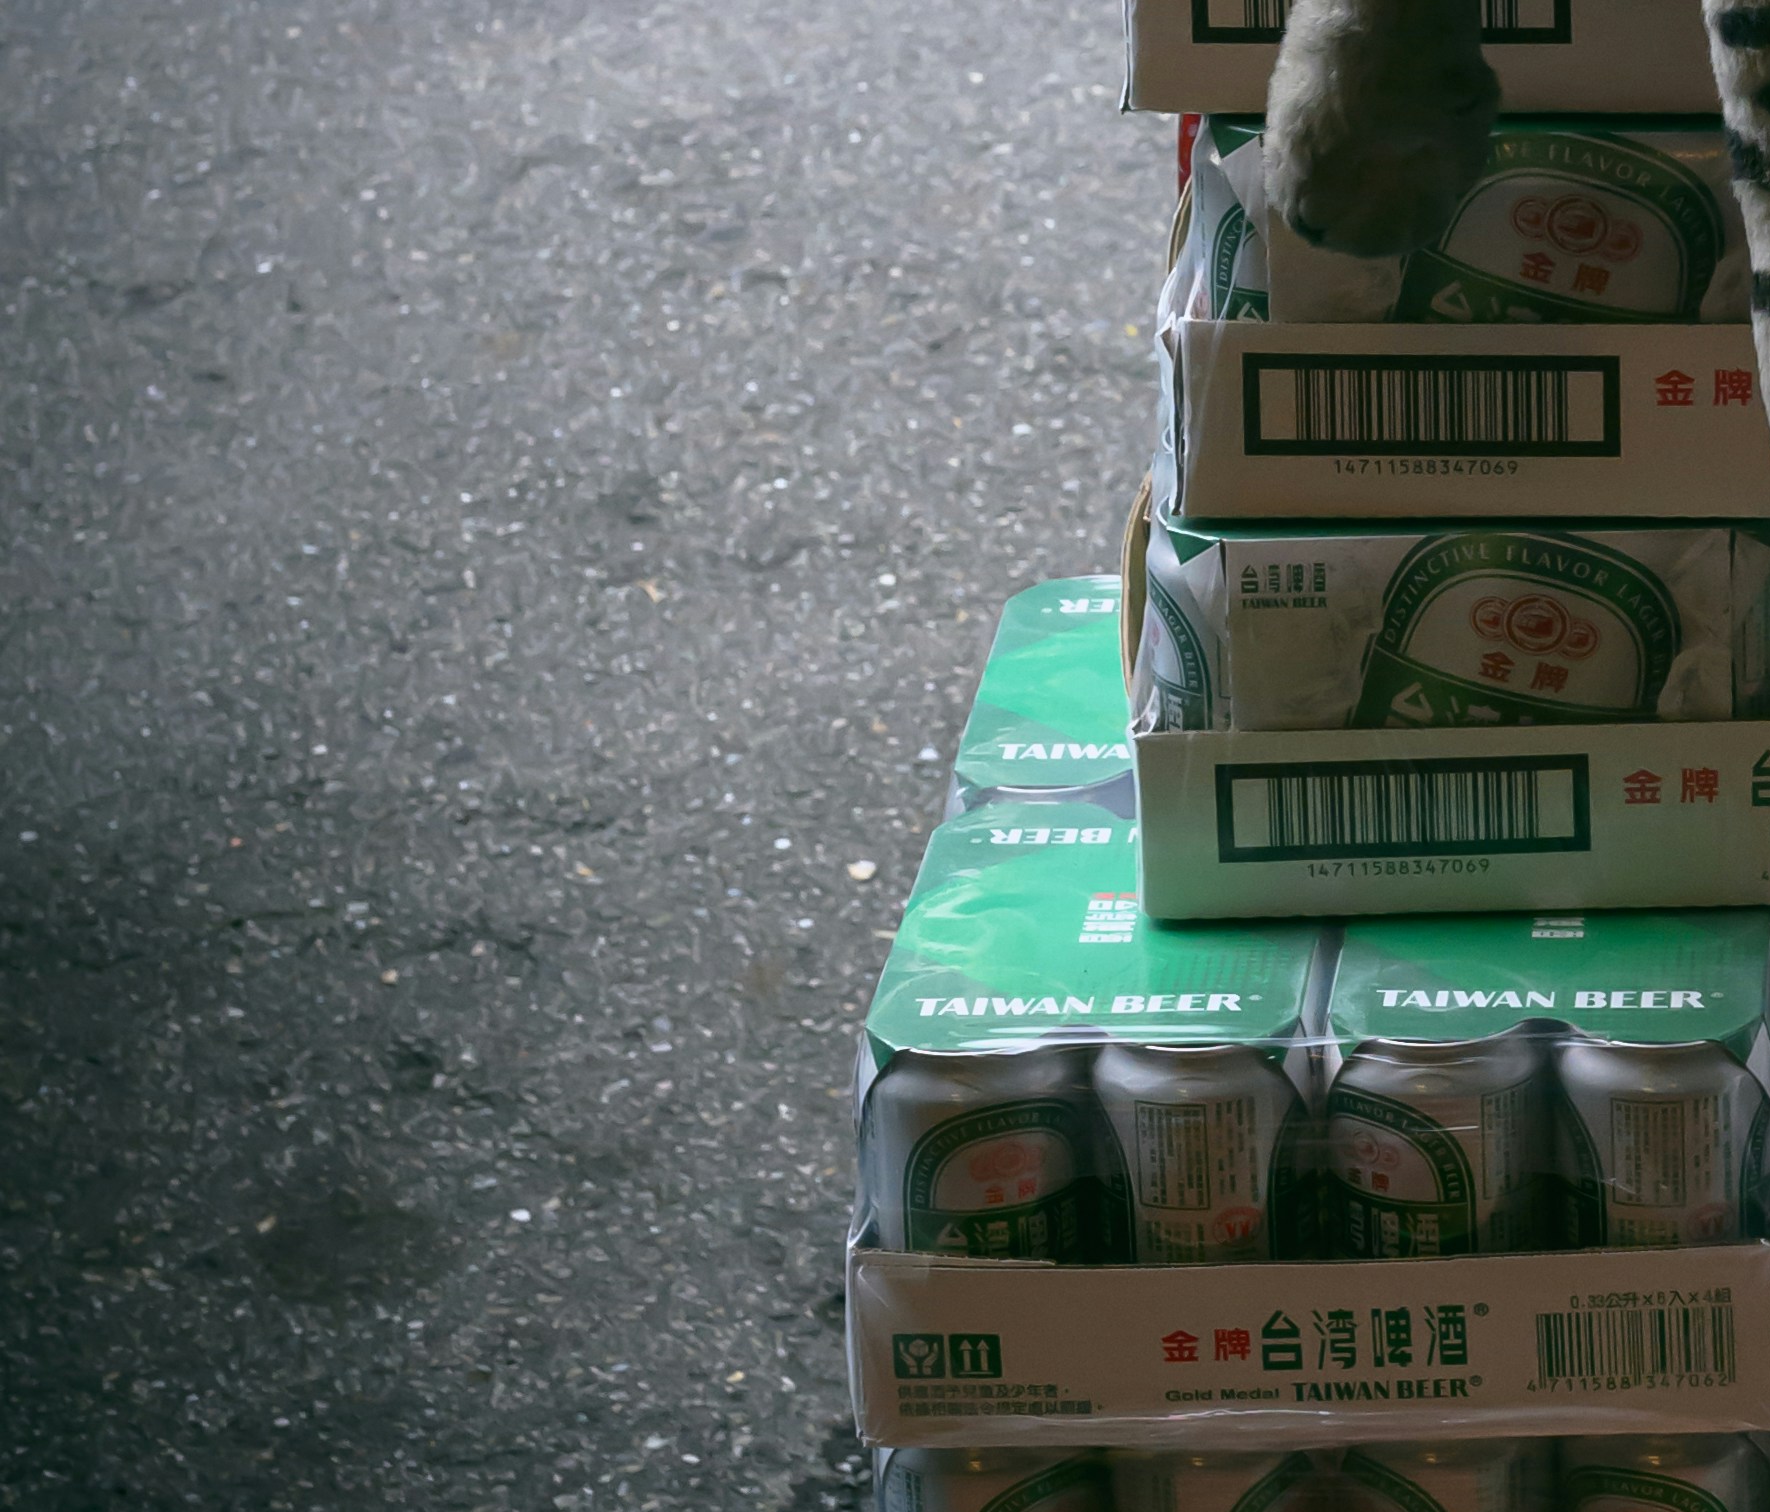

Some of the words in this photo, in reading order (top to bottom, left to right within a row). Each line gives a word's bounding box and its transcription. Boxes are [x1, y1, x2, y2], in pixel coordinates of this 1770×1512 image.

[1548, 143, 1652, 188] FLAVOR
[1655, 368, 1754, 407] 金牌
[1383, 542, 1492, 645] DISTINCTIVE
[1506, 544, 1612, 586] FLAVOR
[1478, 650, 1569, 694] 金牌
[997, 742, 1133, 761] TAIWA
[1622, 767, 1720, 806] 金牌
[988, 827, 1112, 846] BEER
[914, 996, 1095, 1017] TAIWAN
[1110, 992, 1243, 1014] BEER
[1375, 987, 1557, 1011] TAIWAN
[1572, 988, 1706, 1012] BEER
[1161, 1328, 1252, 1364] 金牌
[1165, 1388, 1213, 1403] Gold
[1219, 1387, 1281, 1402] Medal
[1291, 1380, 1391, 1404] TAIWAN
[1397, 1377, 1471, 1401] BEER
